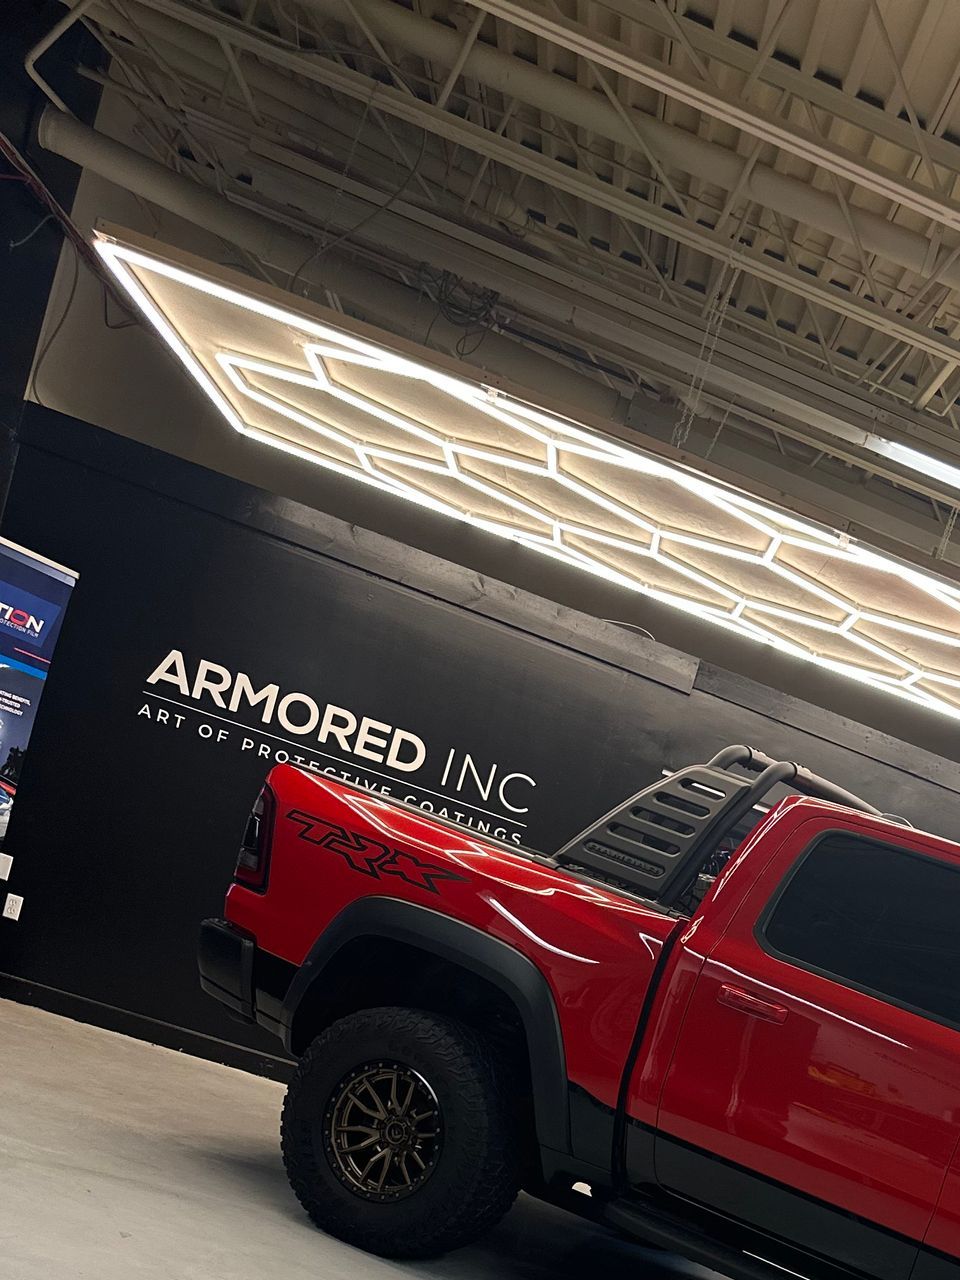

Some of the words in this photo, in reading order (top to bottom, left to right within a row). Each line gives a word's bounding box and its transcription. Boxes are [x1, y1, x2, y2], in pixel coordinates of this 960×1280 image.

[138, 704, 186, 729] ART
[198, 724, 229, 743] OF
[146, 650, 426, 772] ARMORED
[441, 748, 536, 813] INC
[286, 808, 471, 895] TRX
